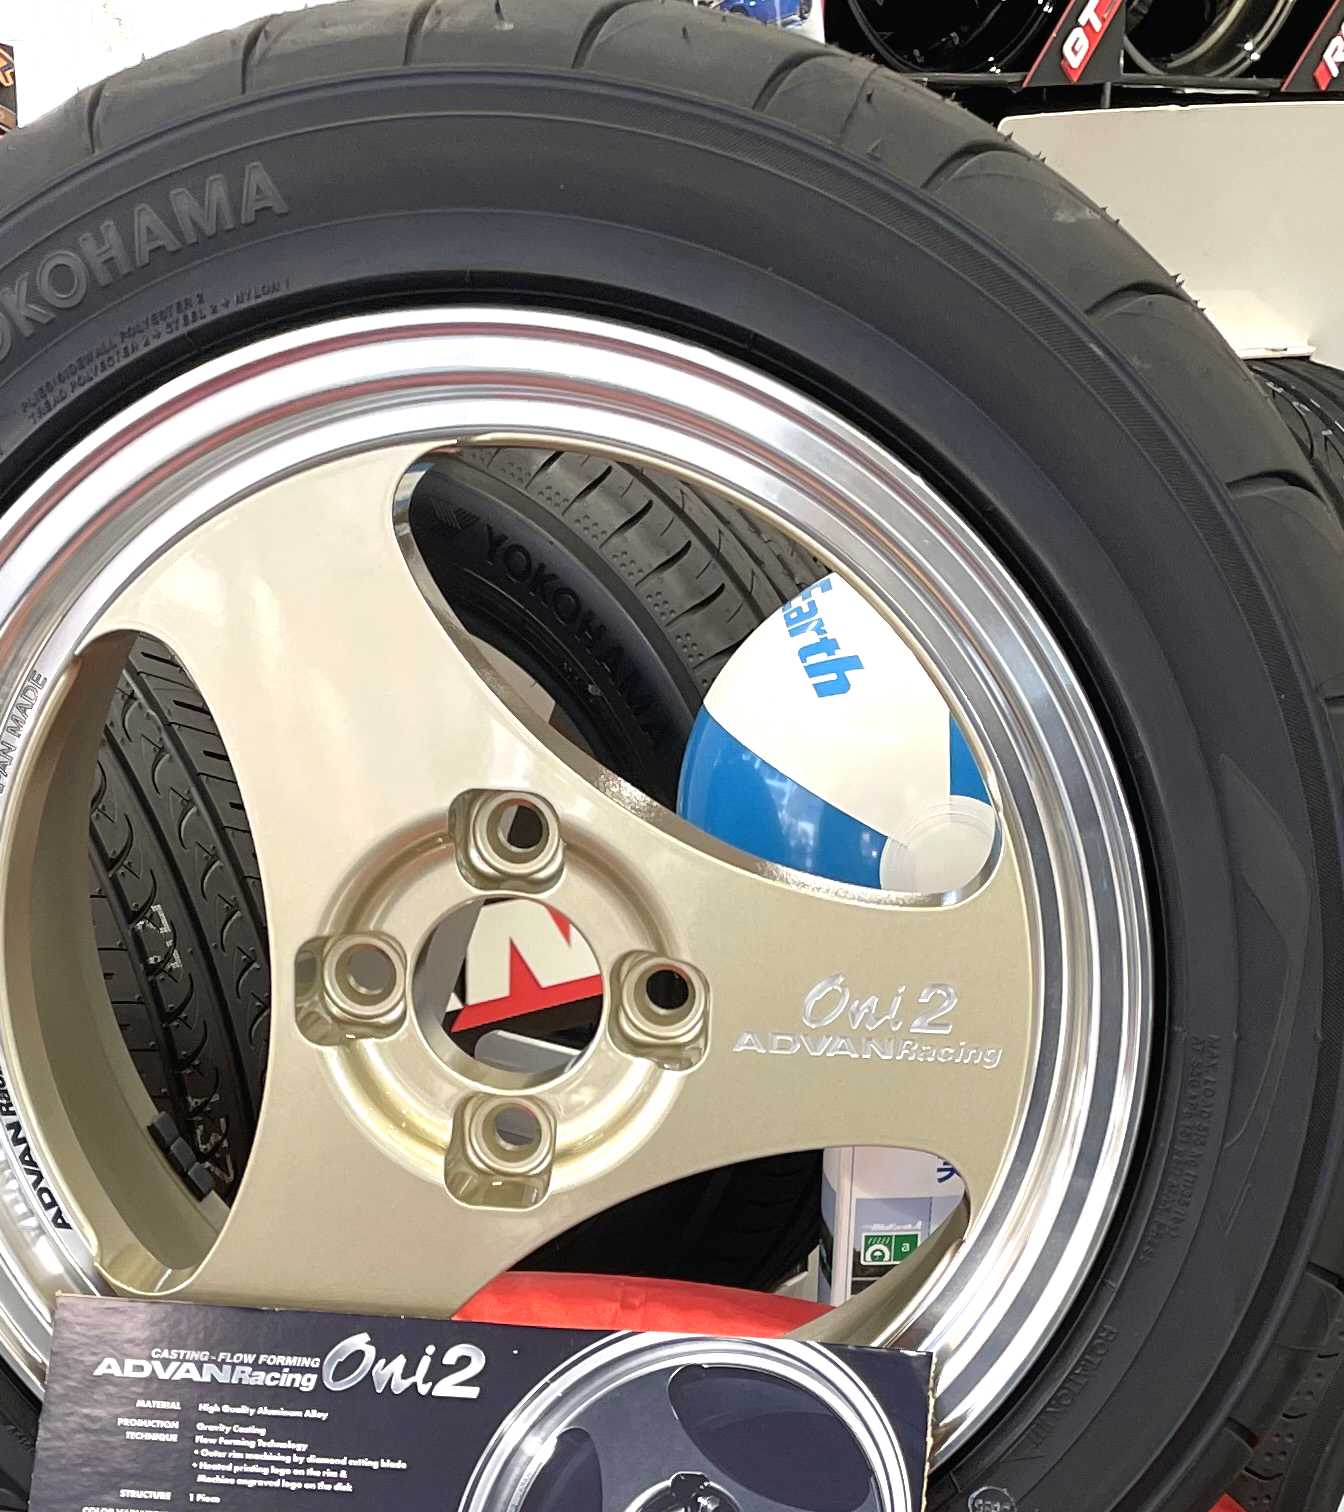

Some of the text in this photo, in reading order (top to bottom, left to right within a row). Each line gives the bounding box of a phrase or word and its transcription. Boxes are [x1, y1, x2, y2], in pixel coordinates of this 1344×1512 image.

[5, 669, 48, 740] MADE
[6, 1123, 73, 1232] ADVAN
[259, 1355, 321, 1369] FORMING
[198, 1403, 221, 1415] High
[117, 1418, 180, 1429] PRODUCTION
[196, 1422, 267, 1436] Gravity Casting
[126, 1431, 178, 1442] TECHNIQUE
[195, 1435, 308, 1452] Flow Forming Technology
[293, 1453, 306, 1465] by
[306, 1467, 321, 1477] the
